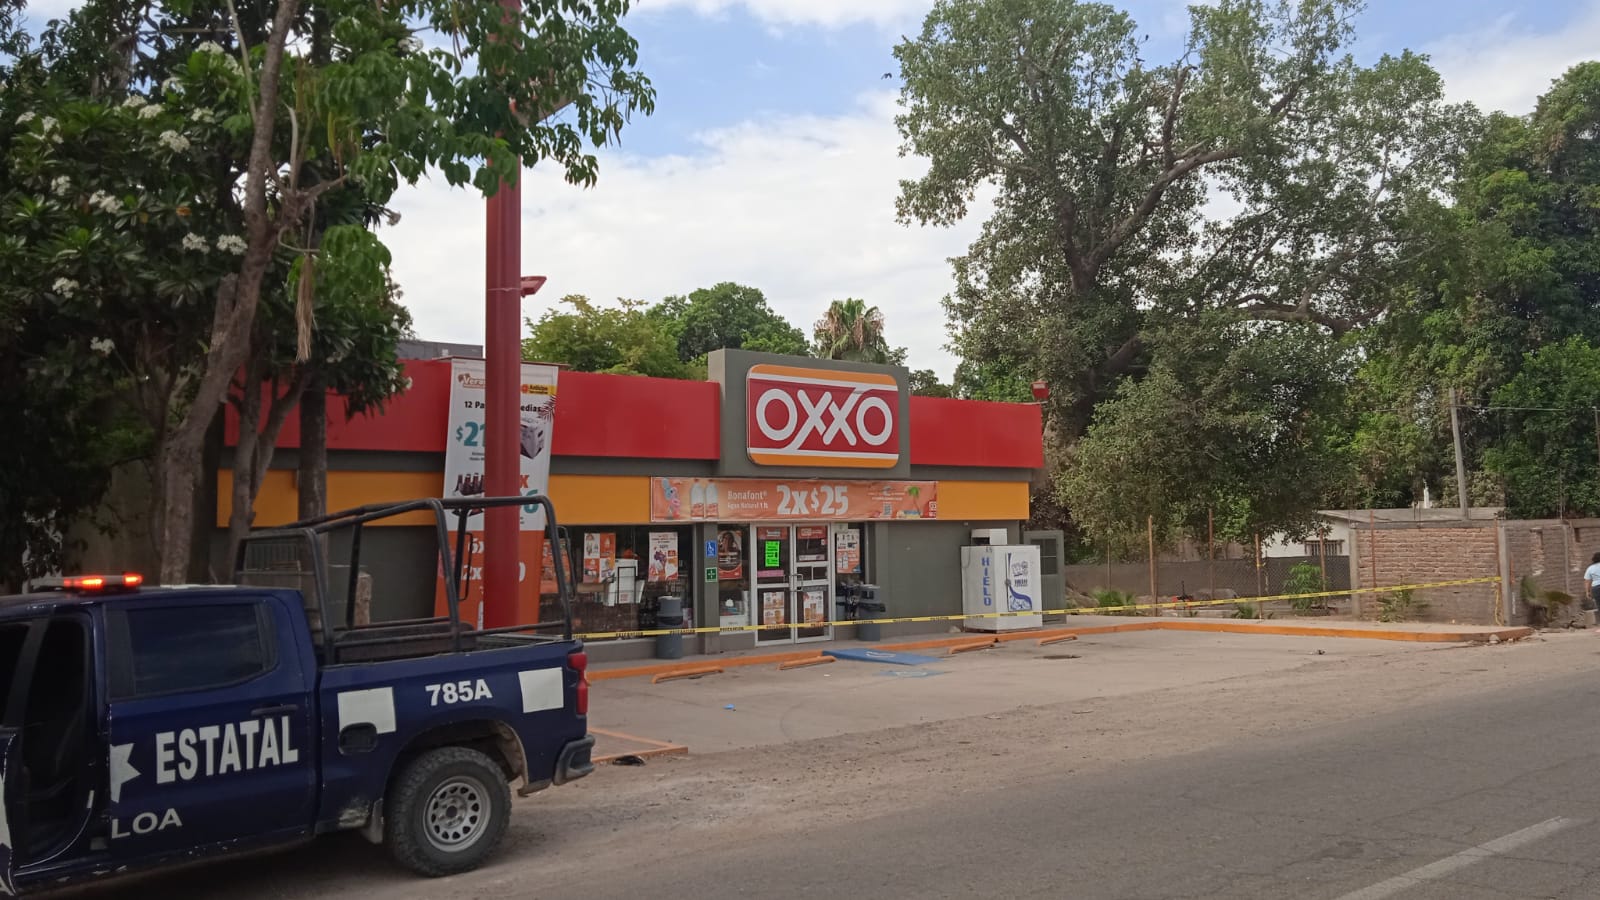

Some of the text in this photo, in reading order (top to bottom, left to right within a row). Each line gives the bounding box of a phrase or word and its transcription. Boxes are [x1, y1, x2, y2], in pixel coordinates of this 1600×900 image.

[475, 401, 485, 409] Pa
[520, 403, 541, 412] edias
[756, 388, 893, 450] OXXO
[777, 485, 849, 516] 2x$25
[981, 557, 992, 606] HIELO
[425, 679, 493, 706] 785A
[156, 716, 299, 784] ESTATAL
